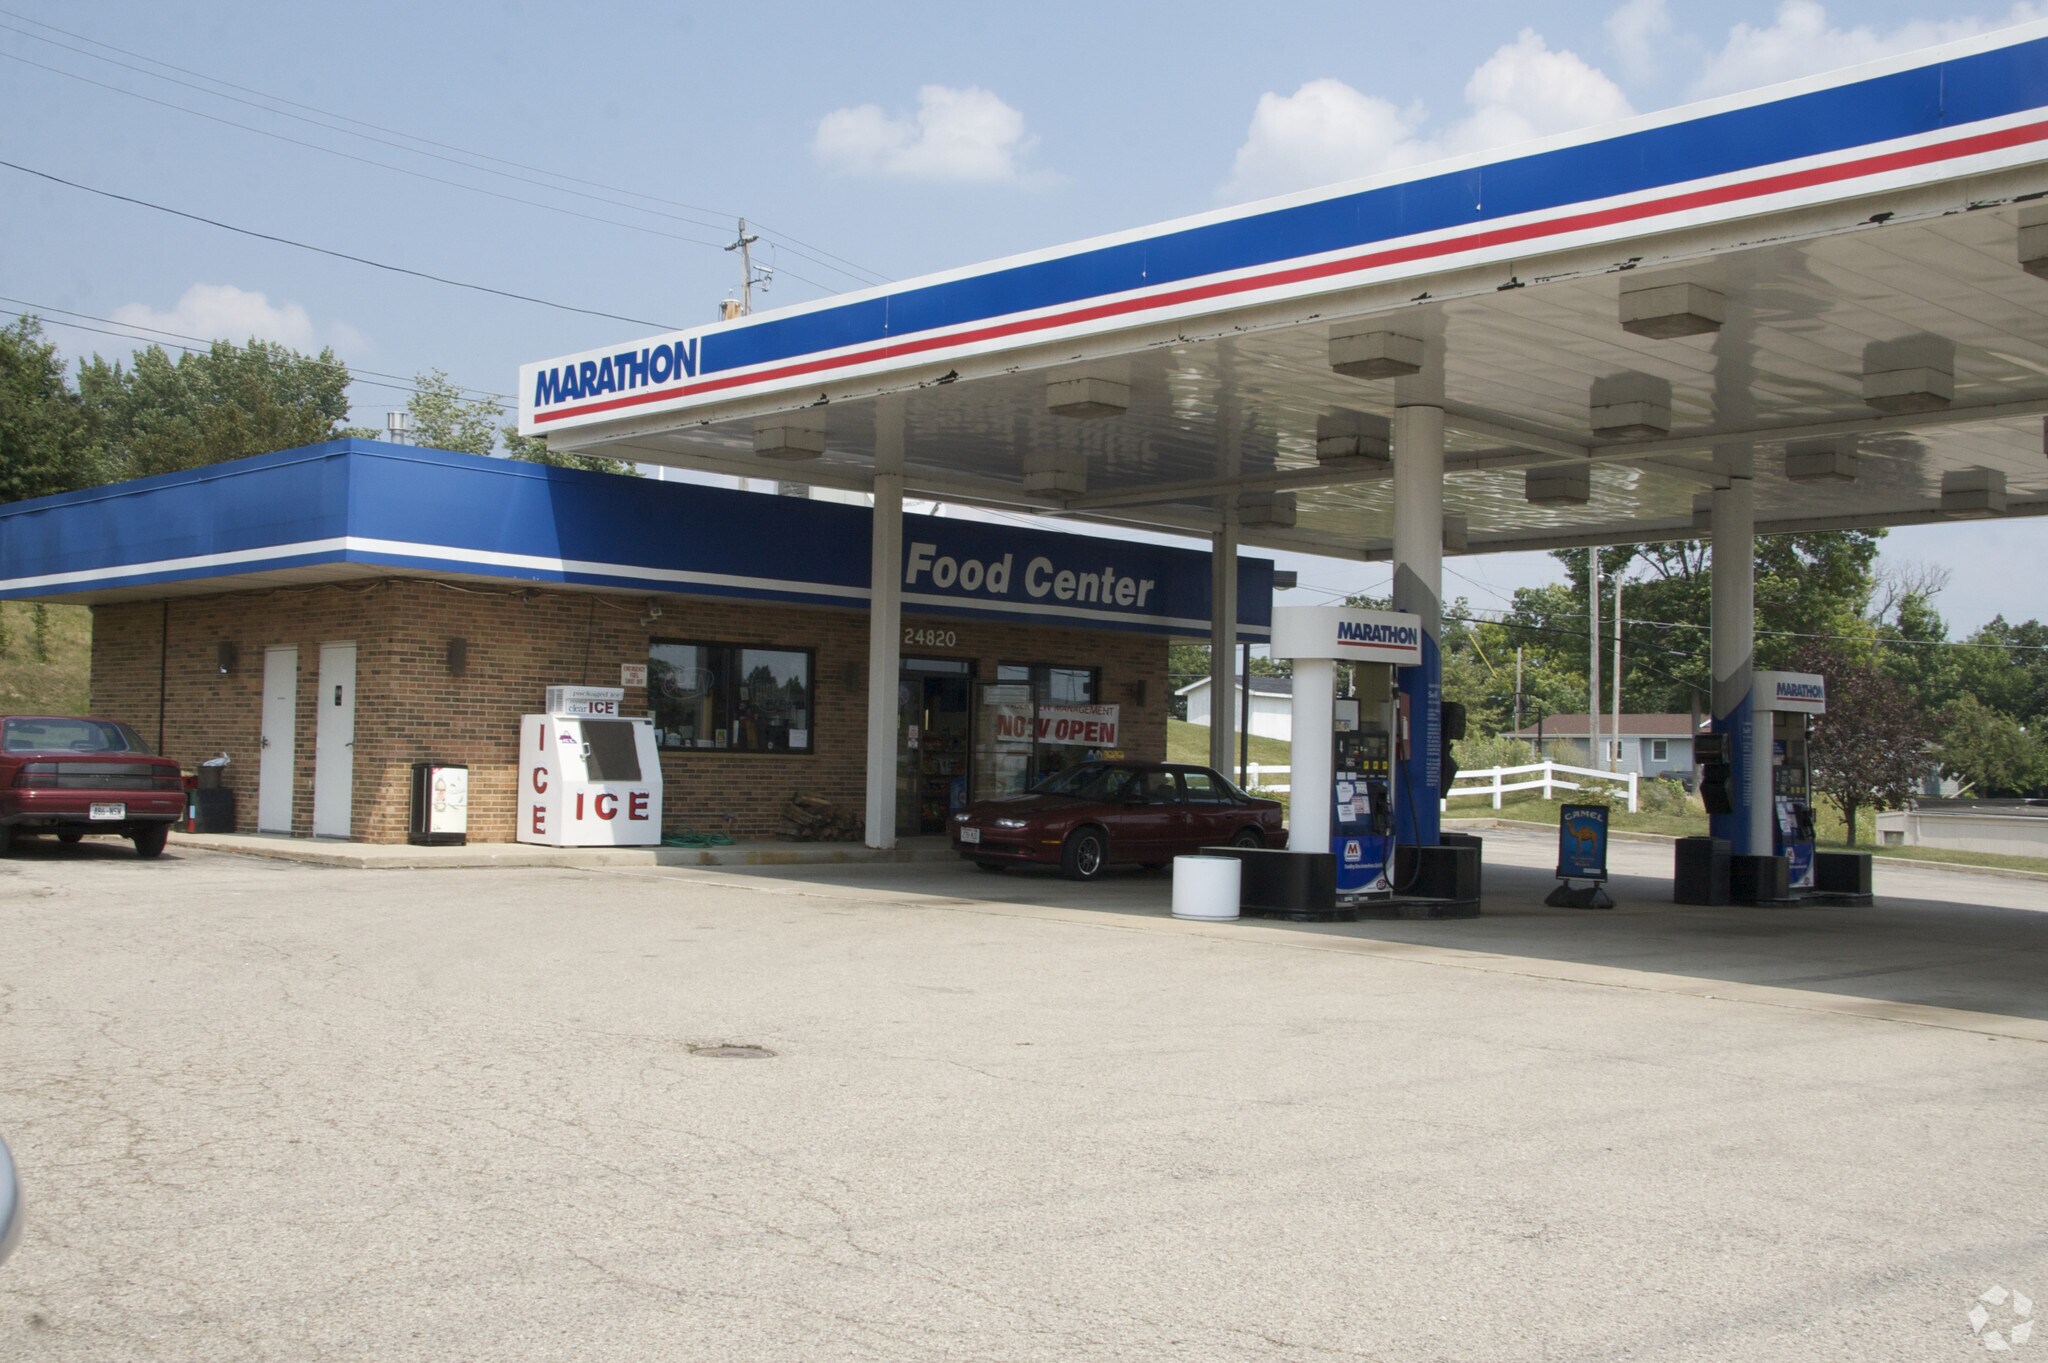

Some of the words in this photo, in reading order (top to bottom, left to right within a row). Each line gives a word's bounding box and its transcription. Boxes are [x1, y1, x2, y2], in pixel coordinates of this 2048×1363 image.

[534, 337, 698, 407] MARATHON
[905, 542, 1013, 594] Food
[1025, 556, 1155, 607] Center
[904, 628, 957, 648] 24820
[1337, 621, 1417, 646] MARATHON
[572, 690, 608, 698] packaged
[1776, 682, 1824, 698] MARATHON
[568, 704, 588, 712] clear
[589, 701, 614, 714] ICE
[1055, 704, 1115, 716] MANAGEMENT
[1055, 719, 1116, 743] OPEN
[532, 721, 549, 835] ICE
[576, 790, 650, 821] ICE
[1564, 810, 1604, 823] CAMEL
